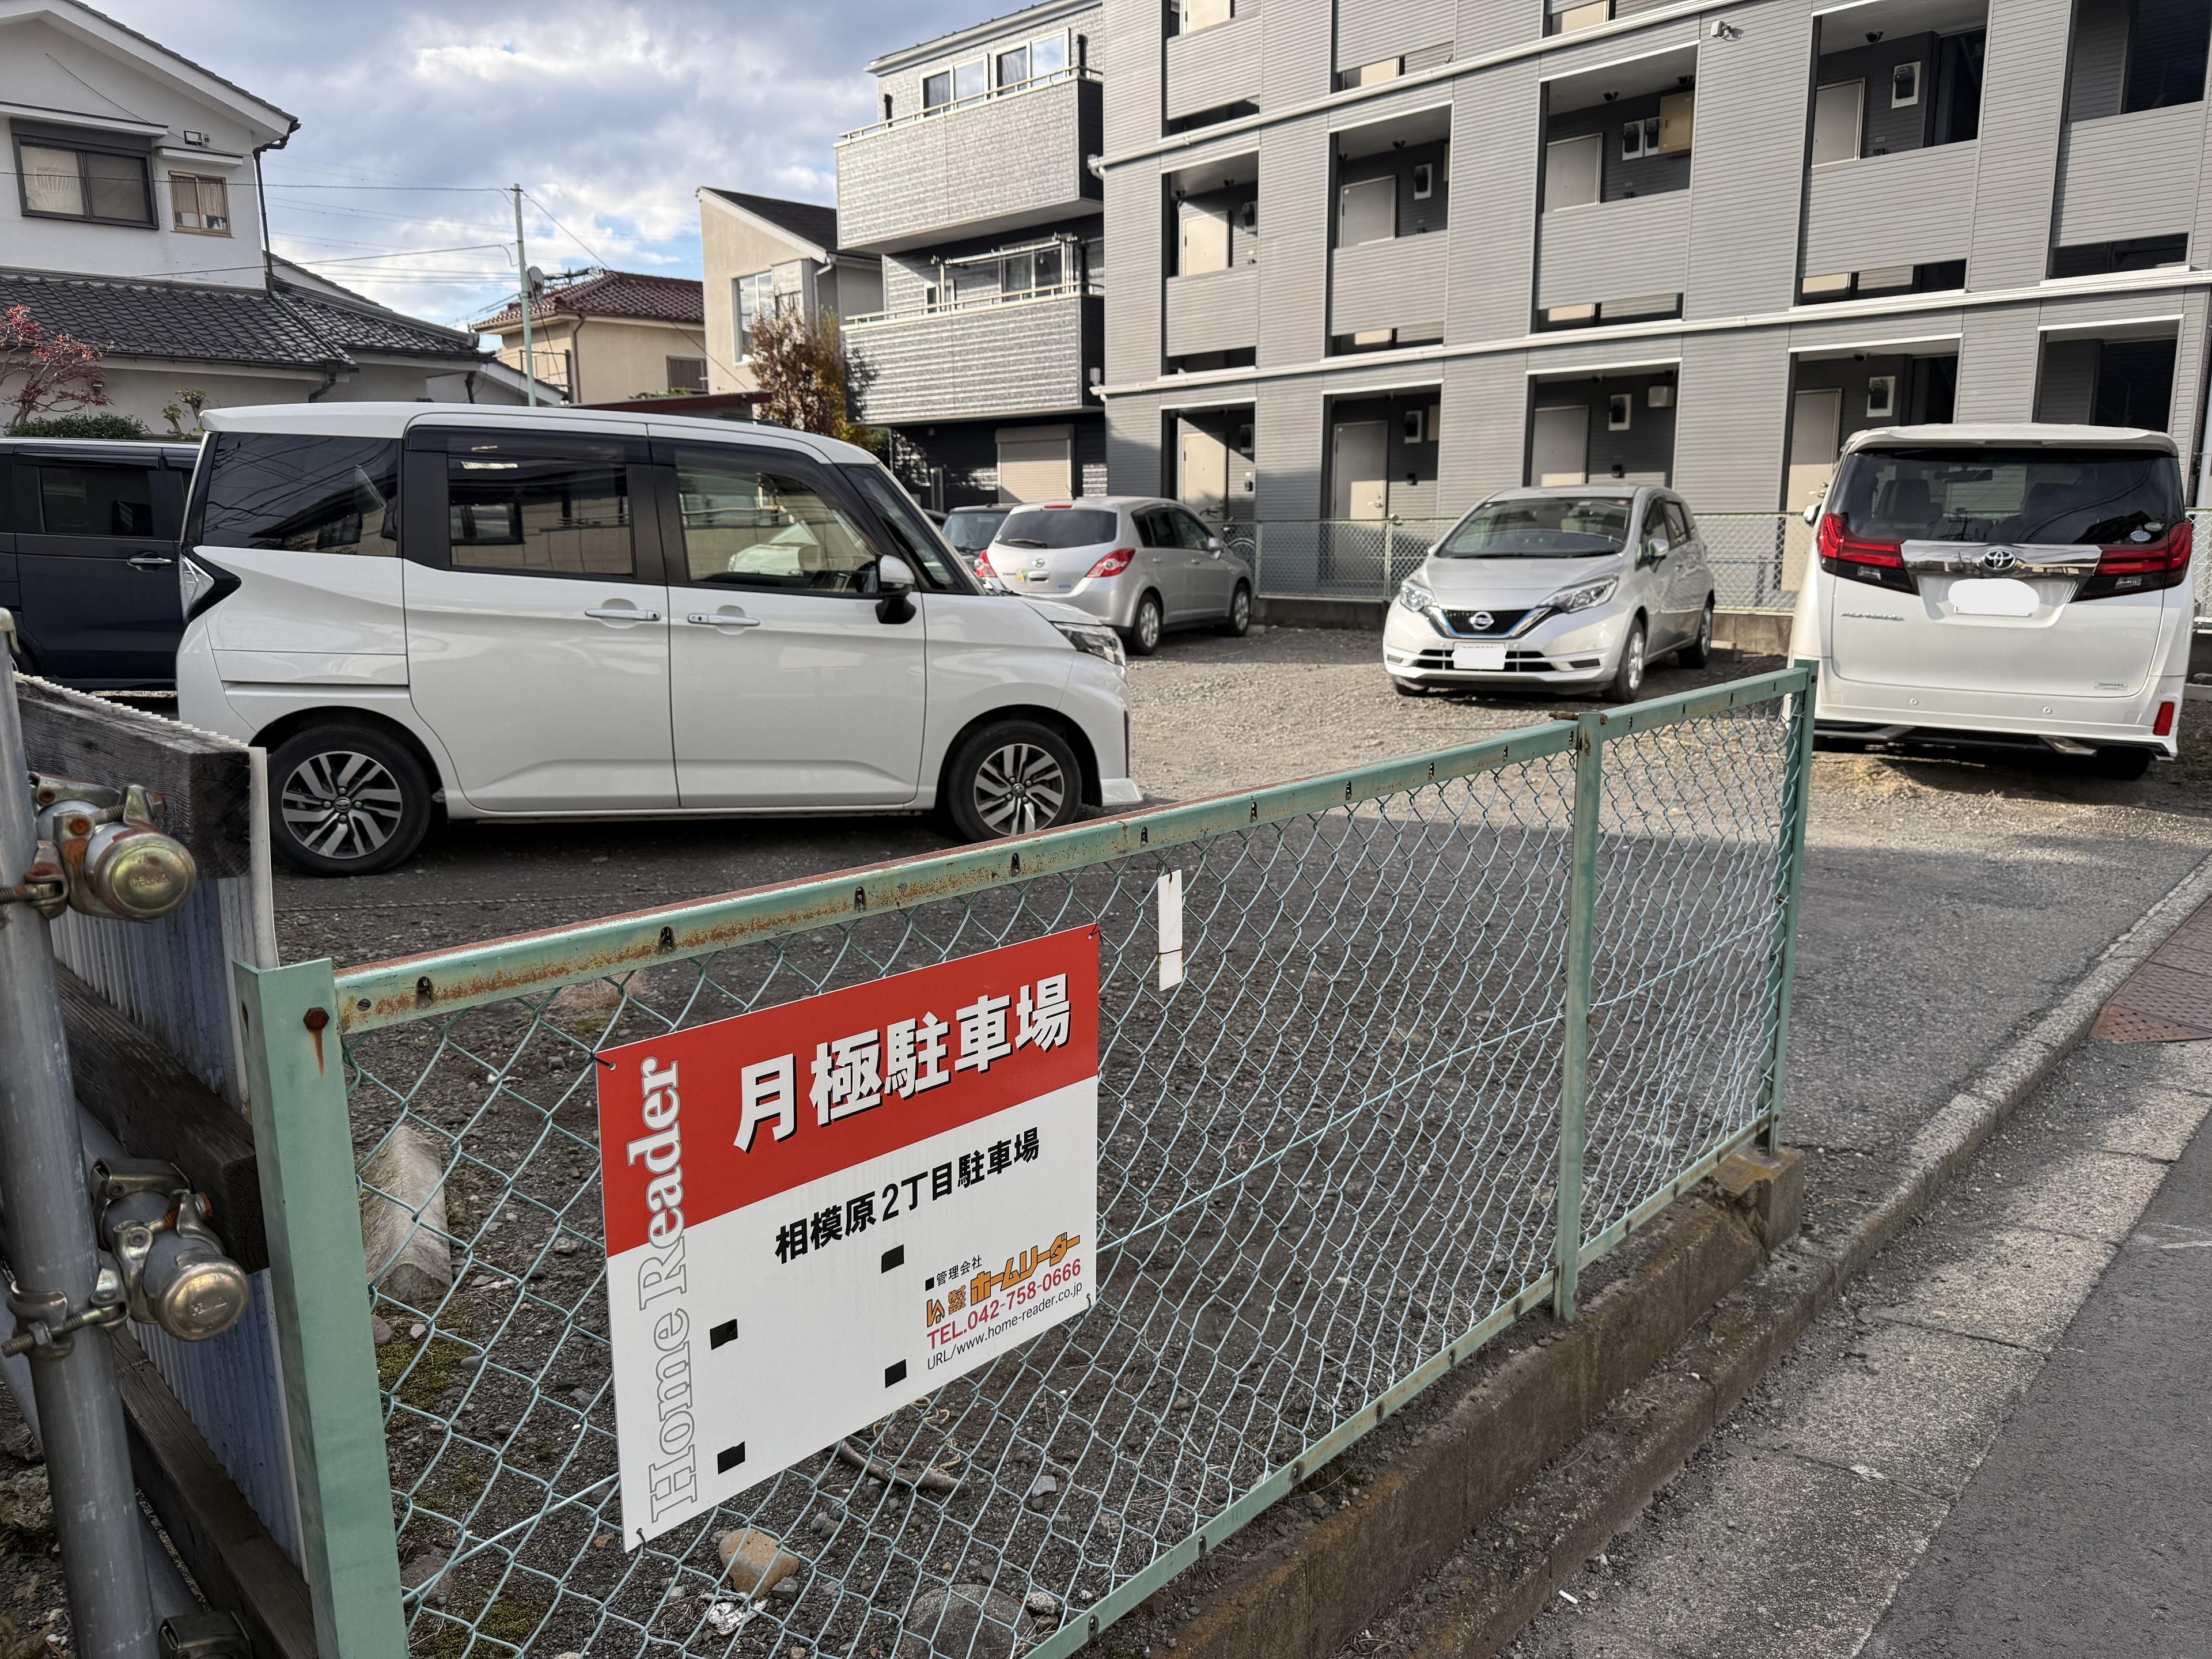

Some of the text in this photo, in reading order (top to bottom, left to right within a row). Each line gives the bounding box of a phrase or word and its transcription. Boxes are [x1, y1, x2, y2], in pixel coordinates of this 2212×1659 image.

[733, 973, 1071, 1154] 月極駐車場
[775, 1127, 1040, 1264] 相模原2丁目駐車場
[627, 1056, 698, 1523] Home Reader
[926, 1257, 1081, 1350] TEL.042-758-0666
[927, 1281, 1083, 1370] URL/www.home-reader.co.jp
[936, 1255, 983, 1287] 管理会社
